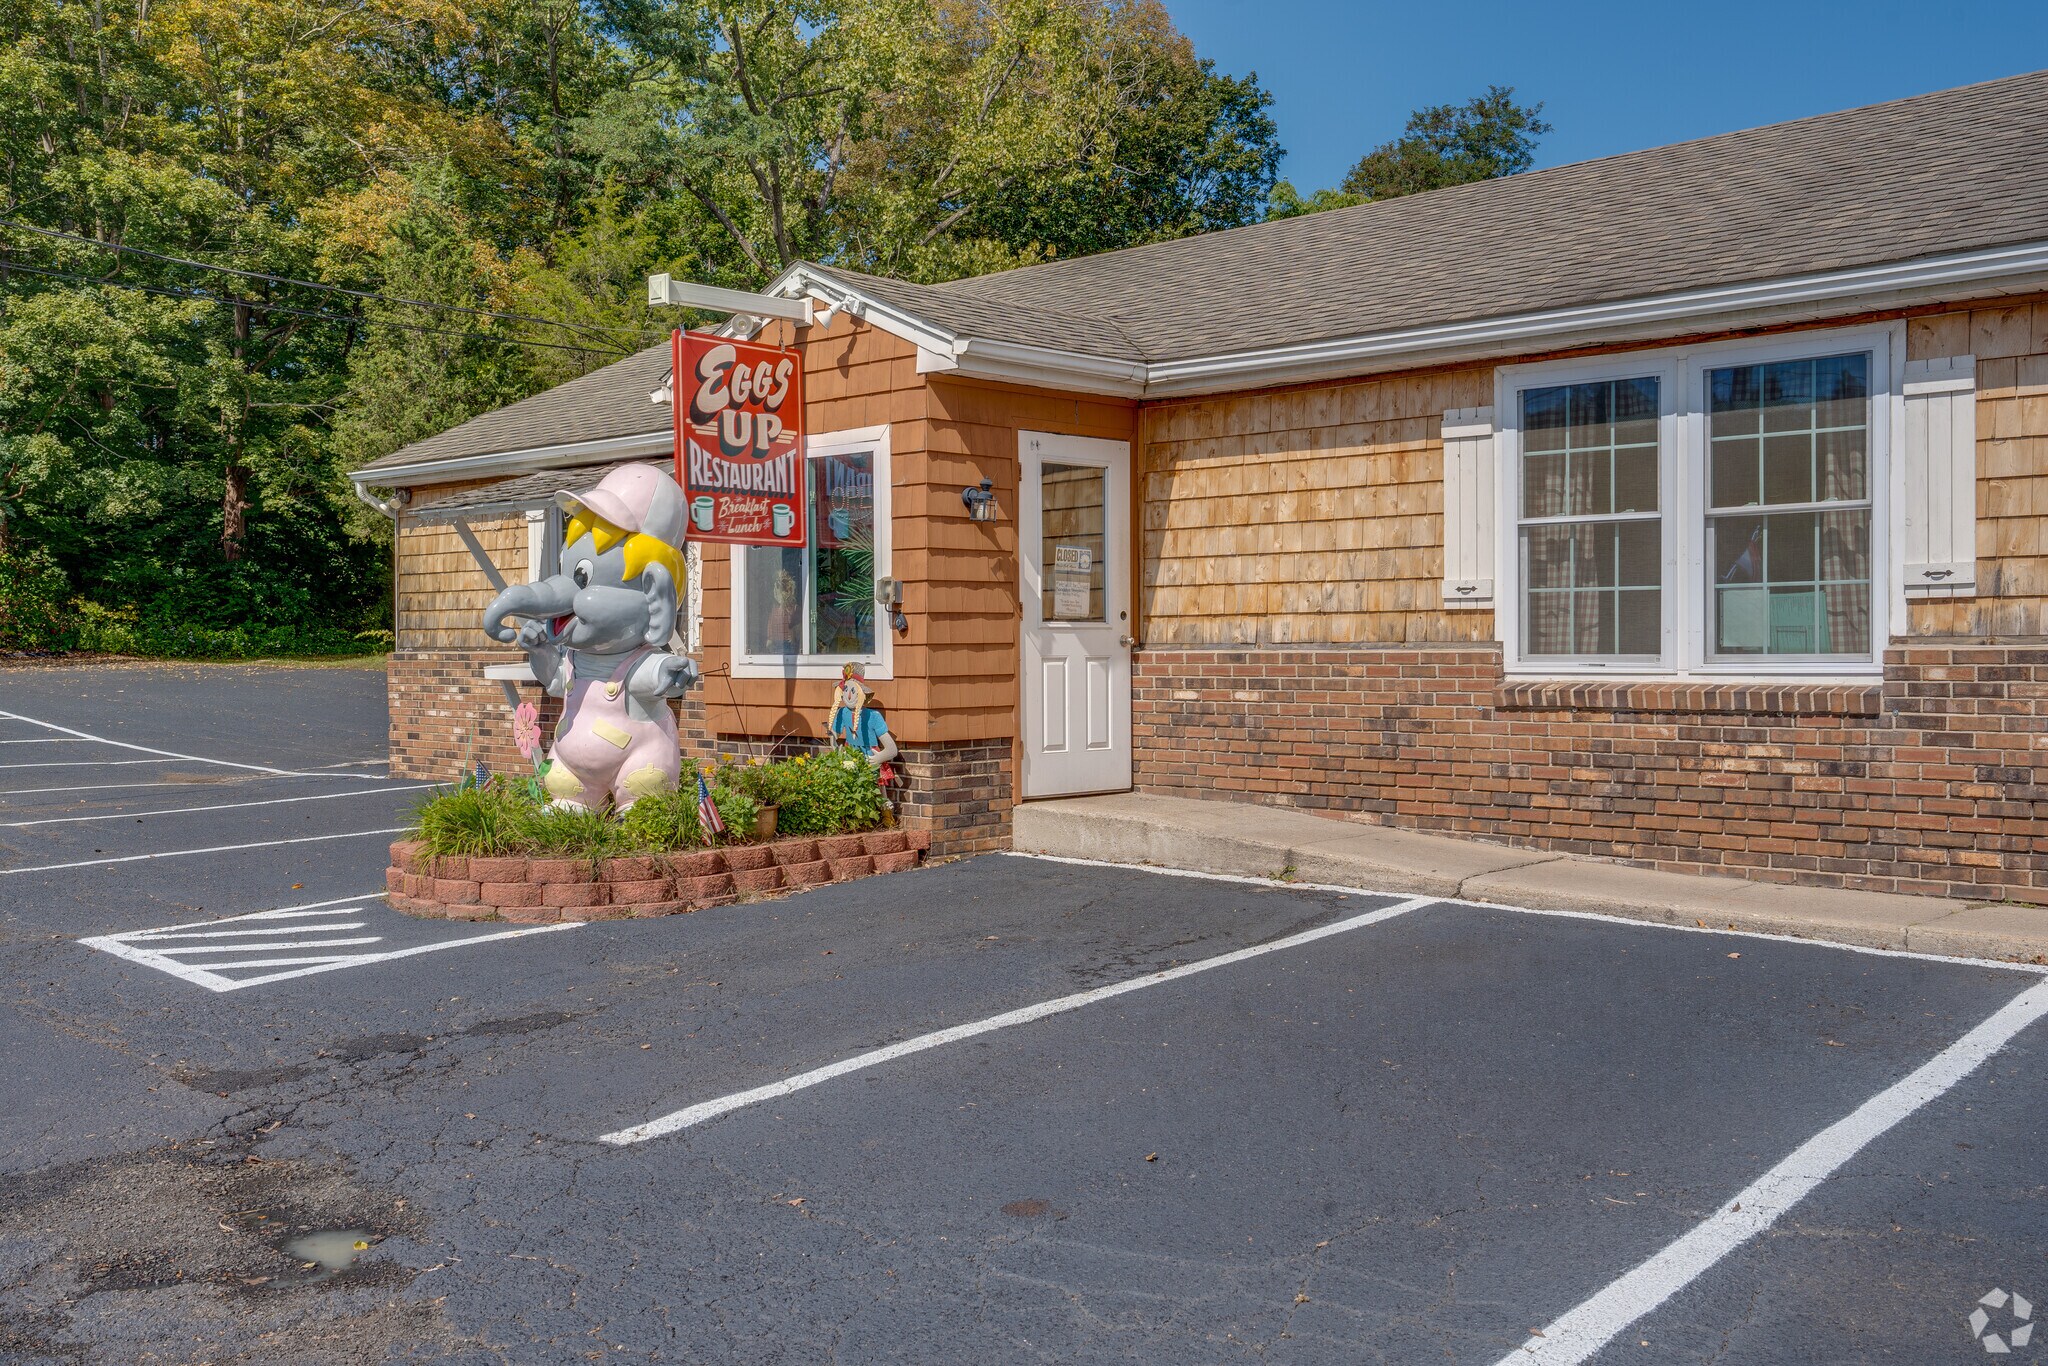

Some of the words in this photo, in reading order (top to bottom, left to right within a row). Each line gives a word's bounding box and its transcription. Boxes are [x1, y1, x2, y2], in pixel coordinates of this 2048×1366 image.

[693, 344, 794, 416] EGGS
[721, 409, 783, 452] UP
[688, 437, 797, 494] RESTAURANT
[718, 496, 771, 519] Breakfast
[831, 484, 873, 512] OPE
[727, 516, 763, 534] Lunch
[1056, 549, 1079, 563] CLOSED
